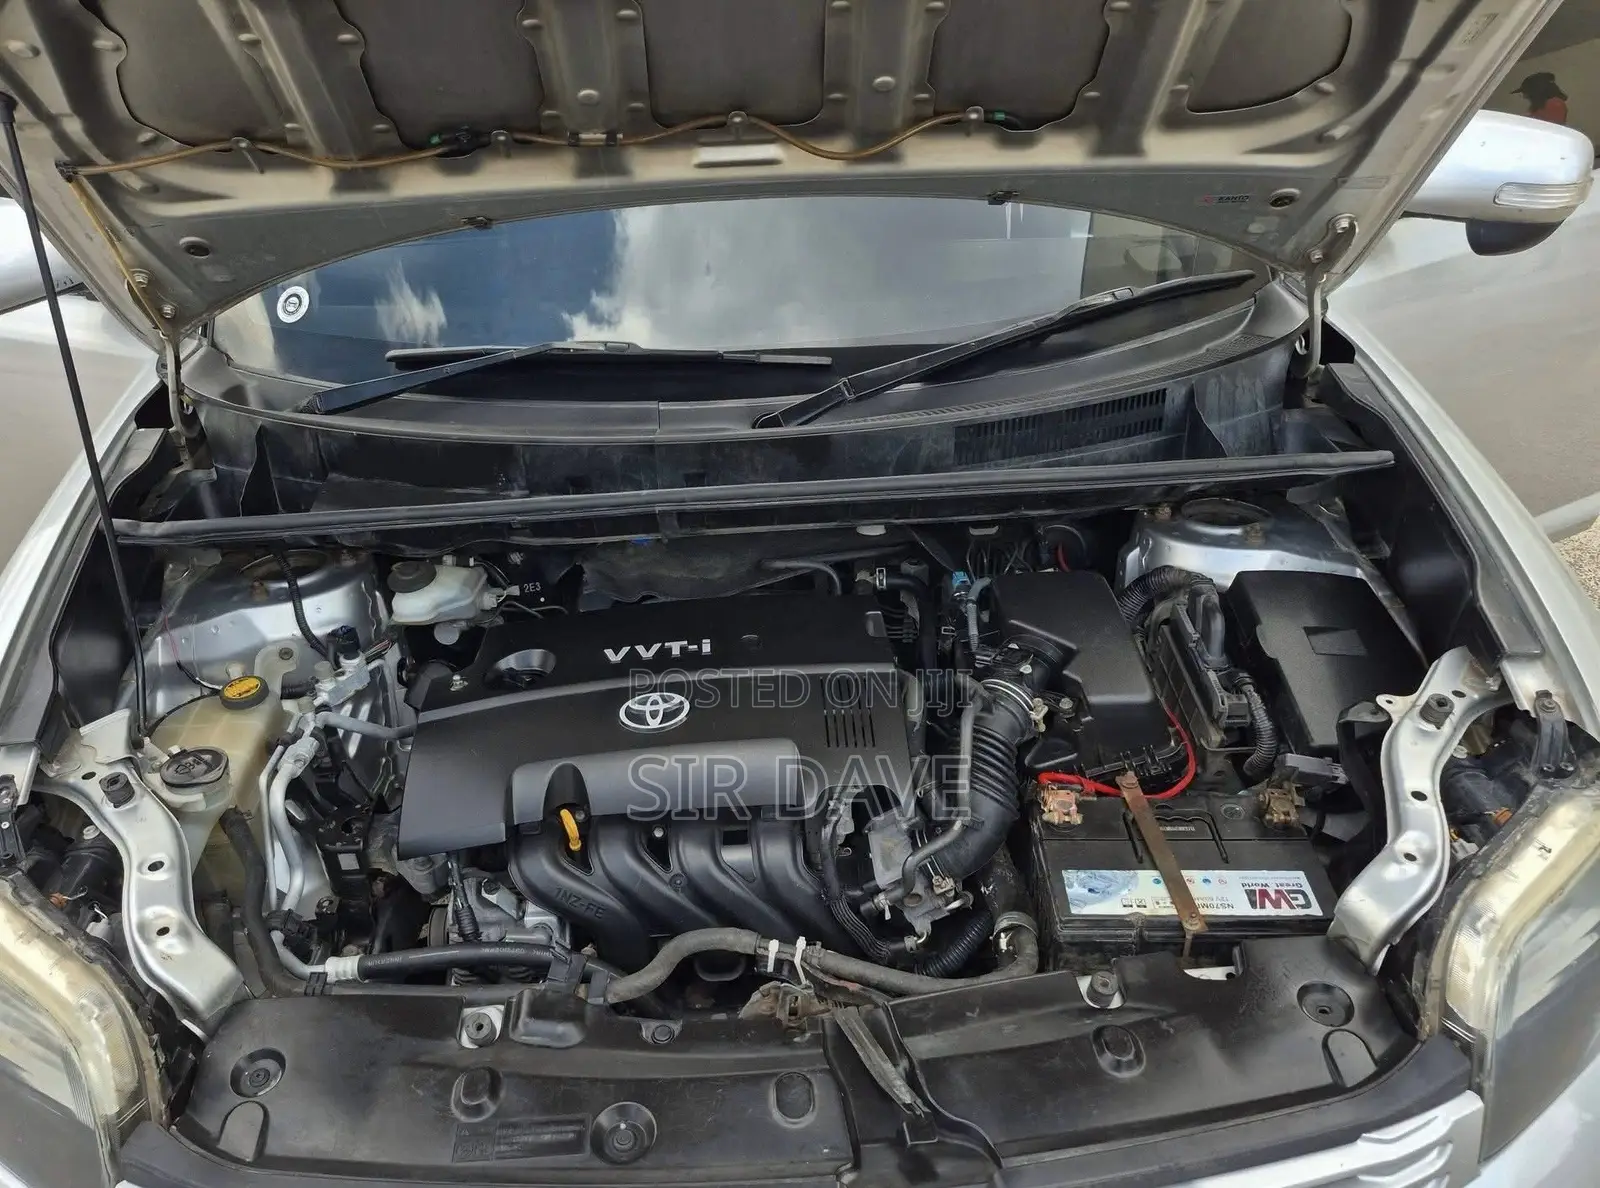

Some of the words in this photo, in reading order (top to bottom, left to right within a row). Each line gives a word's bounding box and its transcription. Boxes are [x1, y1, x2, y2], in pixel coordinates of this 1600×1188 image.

[523, 581, 541, 593] 2E3
[603, 638, 711, 664] VVT-i
[554, 887, 607, 919] 1NZ-FE
